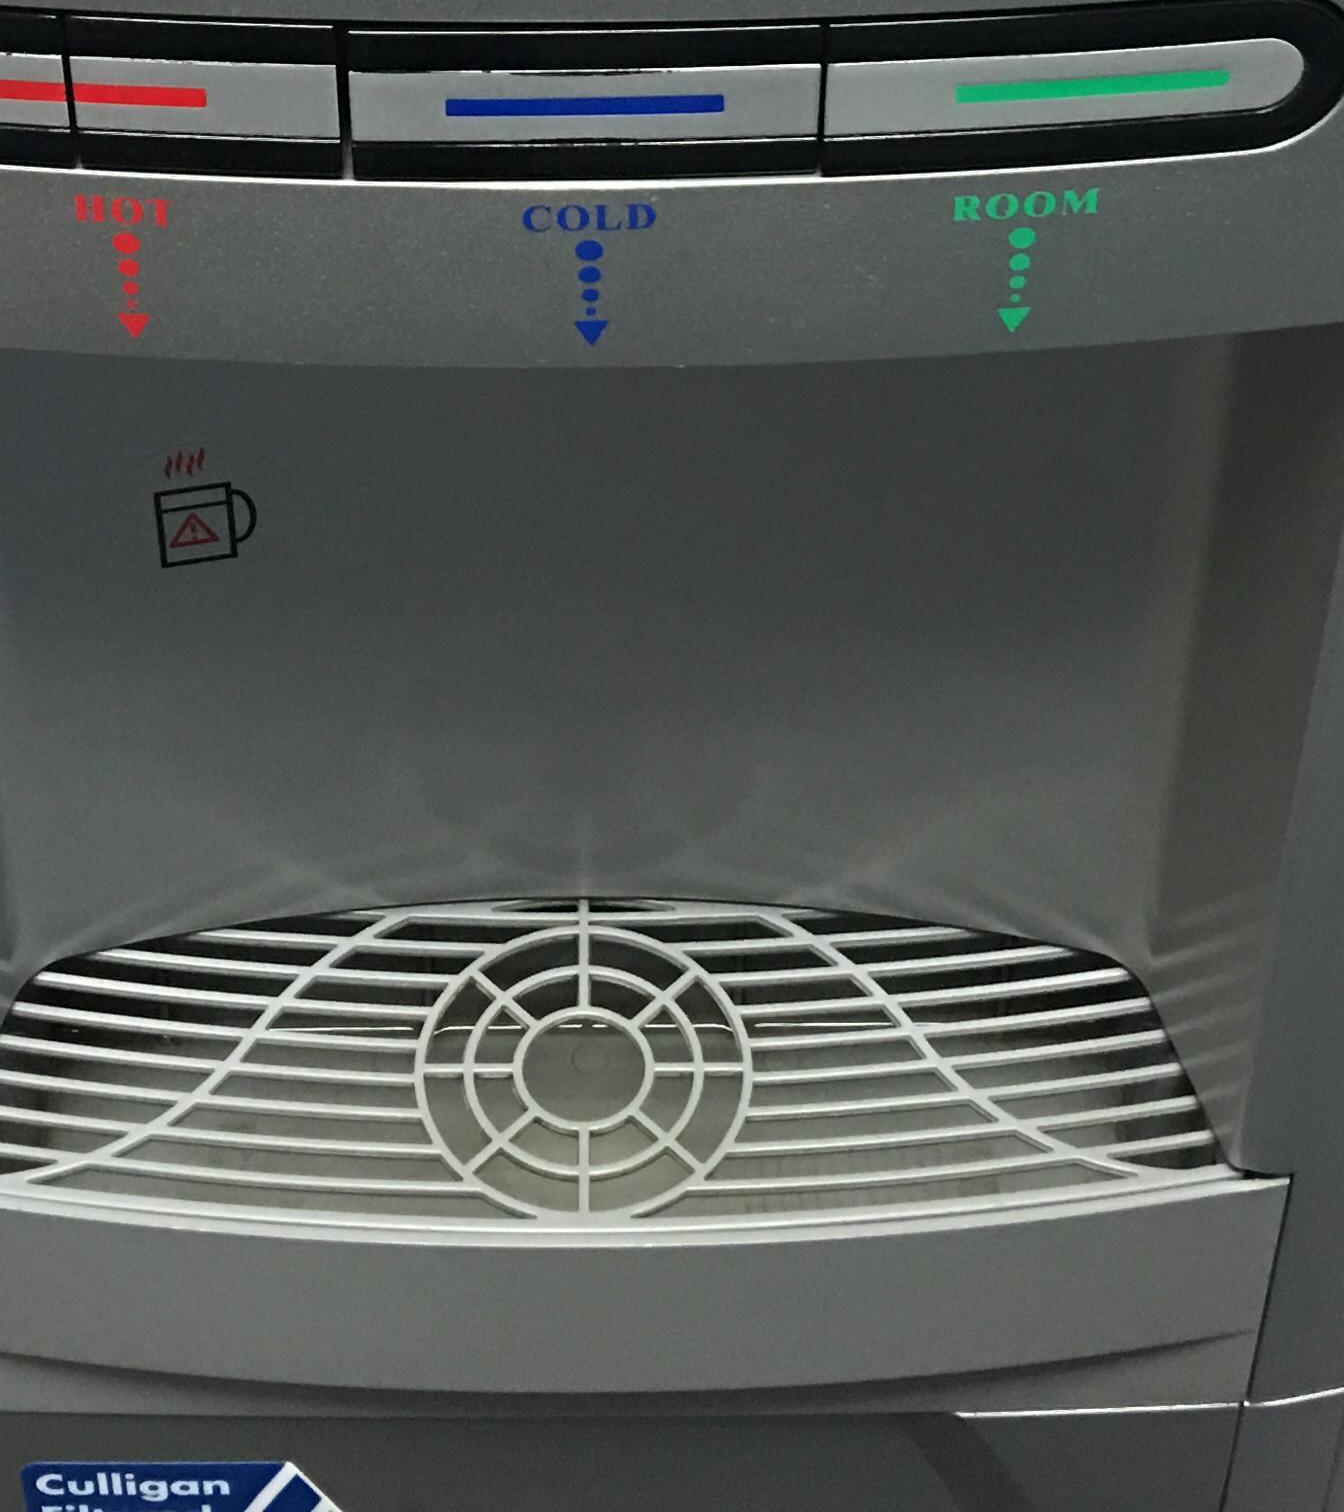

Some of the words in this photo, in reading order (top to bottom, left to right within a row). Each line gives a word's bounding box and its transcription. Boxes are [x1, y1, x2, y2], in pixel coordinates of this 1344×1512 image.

[74, 193, 175, 230] HOT
[521, 202, 657, 233] COLD
[953, 188, 1102, 222] ROOM
[35, 1472, 231, 1502] Culligan
